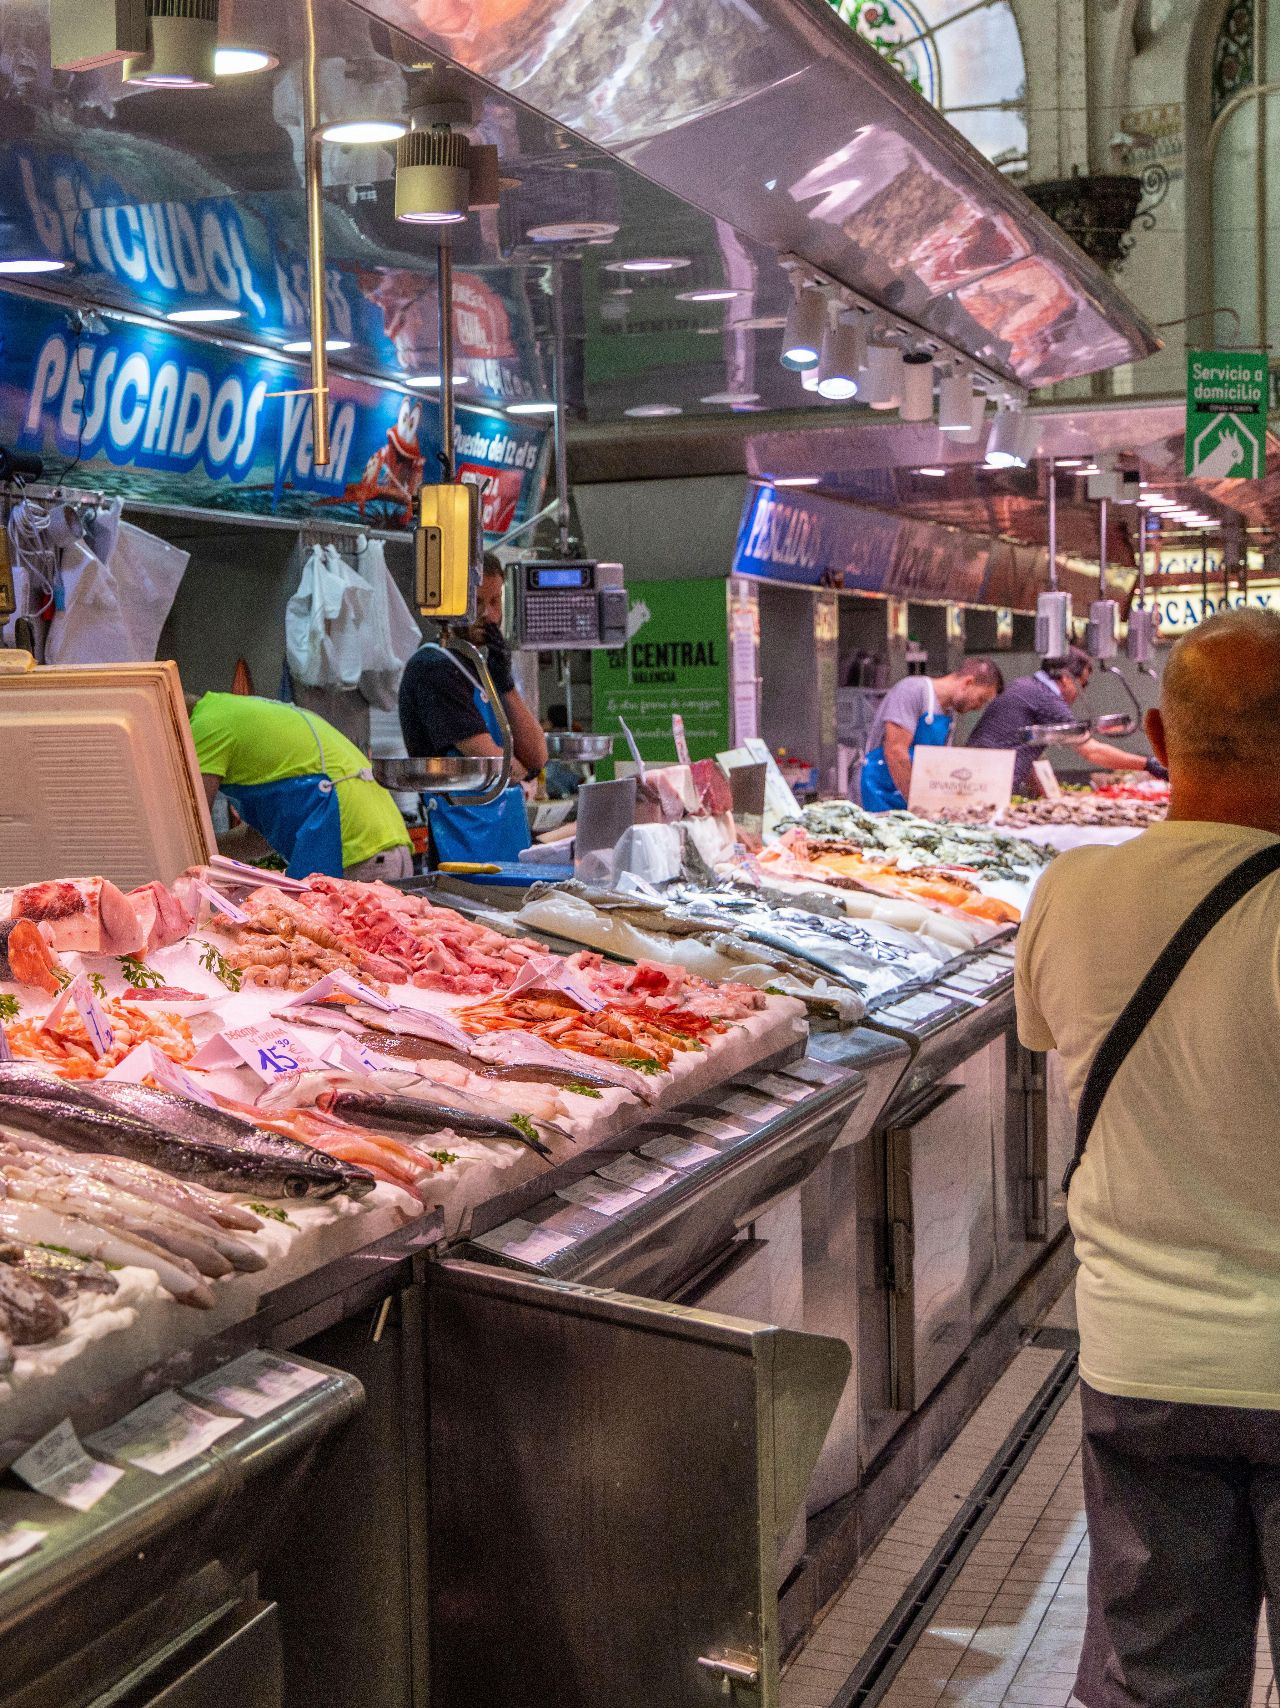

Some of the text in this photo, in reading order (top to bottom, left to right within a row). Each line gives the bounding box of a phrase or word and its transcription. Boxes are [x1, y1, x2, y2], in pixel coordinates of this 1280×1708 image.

[1192, 363, 1263, 381] Servicio a
[25, 335, 267, 467] PESCADOS
[632, 641, 719, 668] CENTRAL
